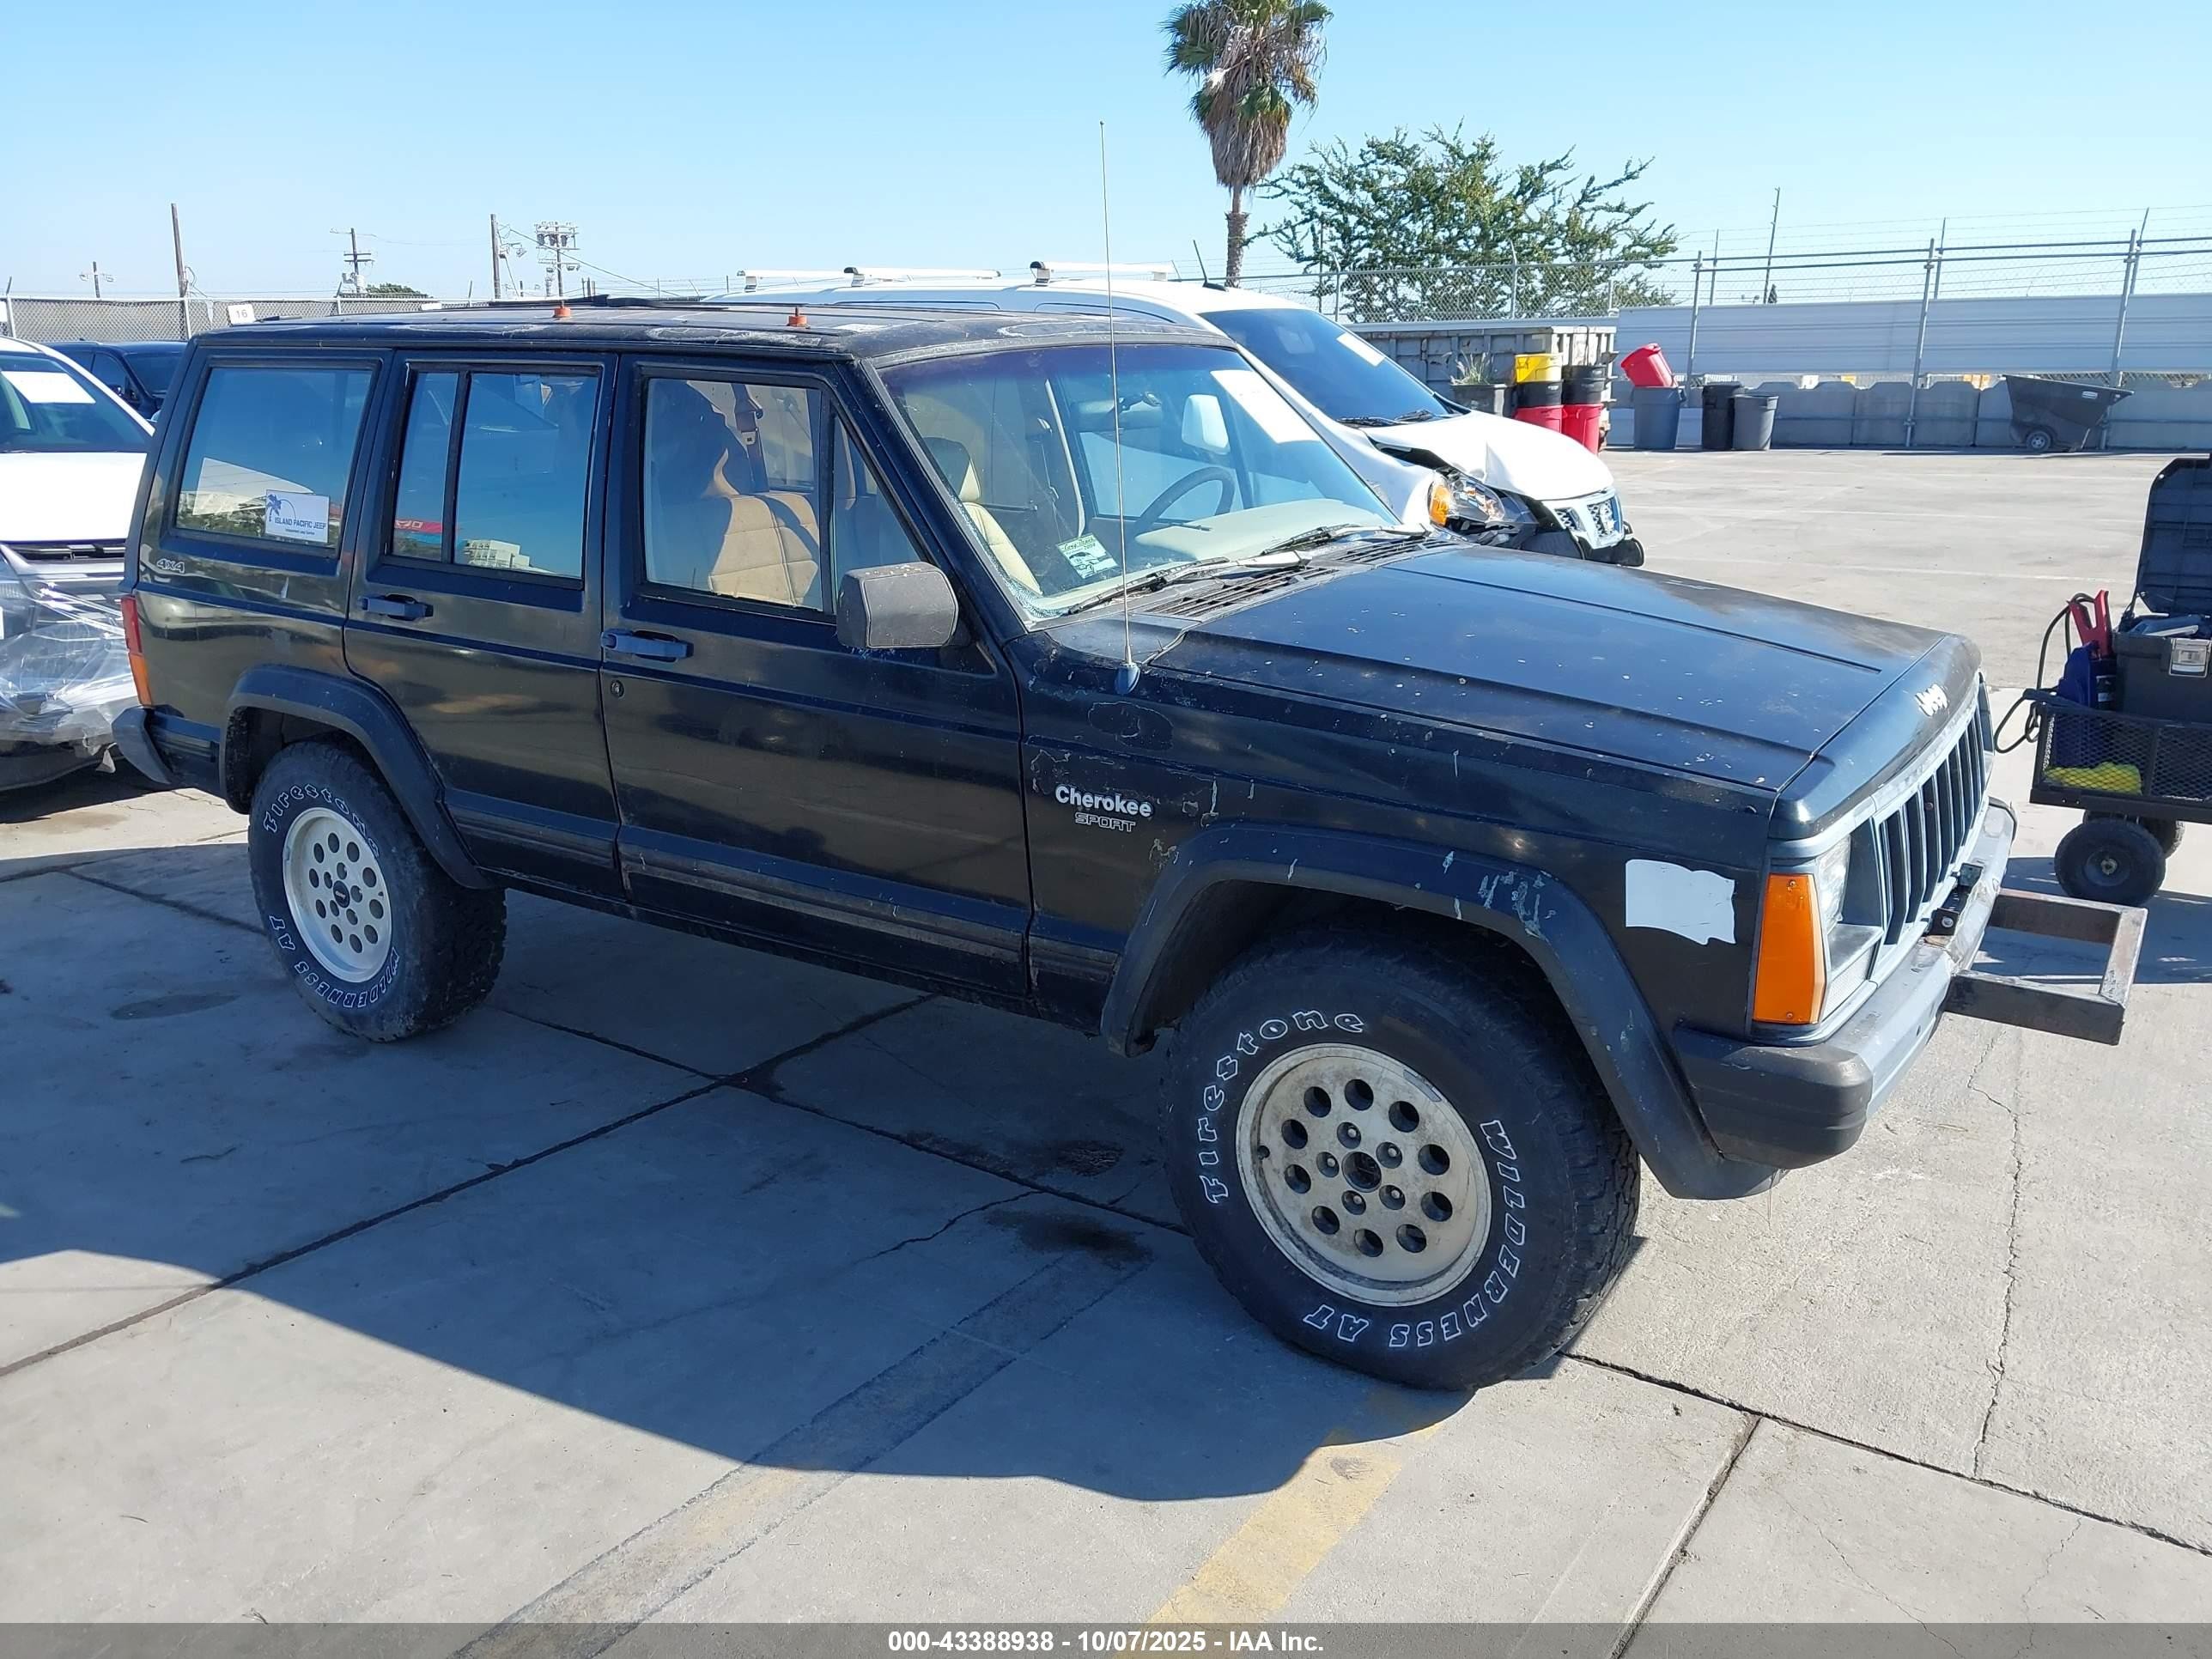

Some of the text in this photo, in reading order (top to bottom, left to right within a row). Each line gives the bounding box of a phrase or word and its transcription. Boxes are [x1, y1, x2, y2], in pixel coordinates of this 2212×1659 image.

[235, 309, 247, 319] 16
[274, 517, 326, 530] ISLAND PACIFIC JEEP
[263, 782, 380, 858] Firestone
[1054, 784, 1152, 817] Cherokee
[1074, 811, 1137, 833] SPORT
[269, 915, 401, 1008] WILDERNESS AT
[1194, 1008, 1365, 1205] Firestone
[1302, 1119, 1528, 1347] WILDERNESS AT
